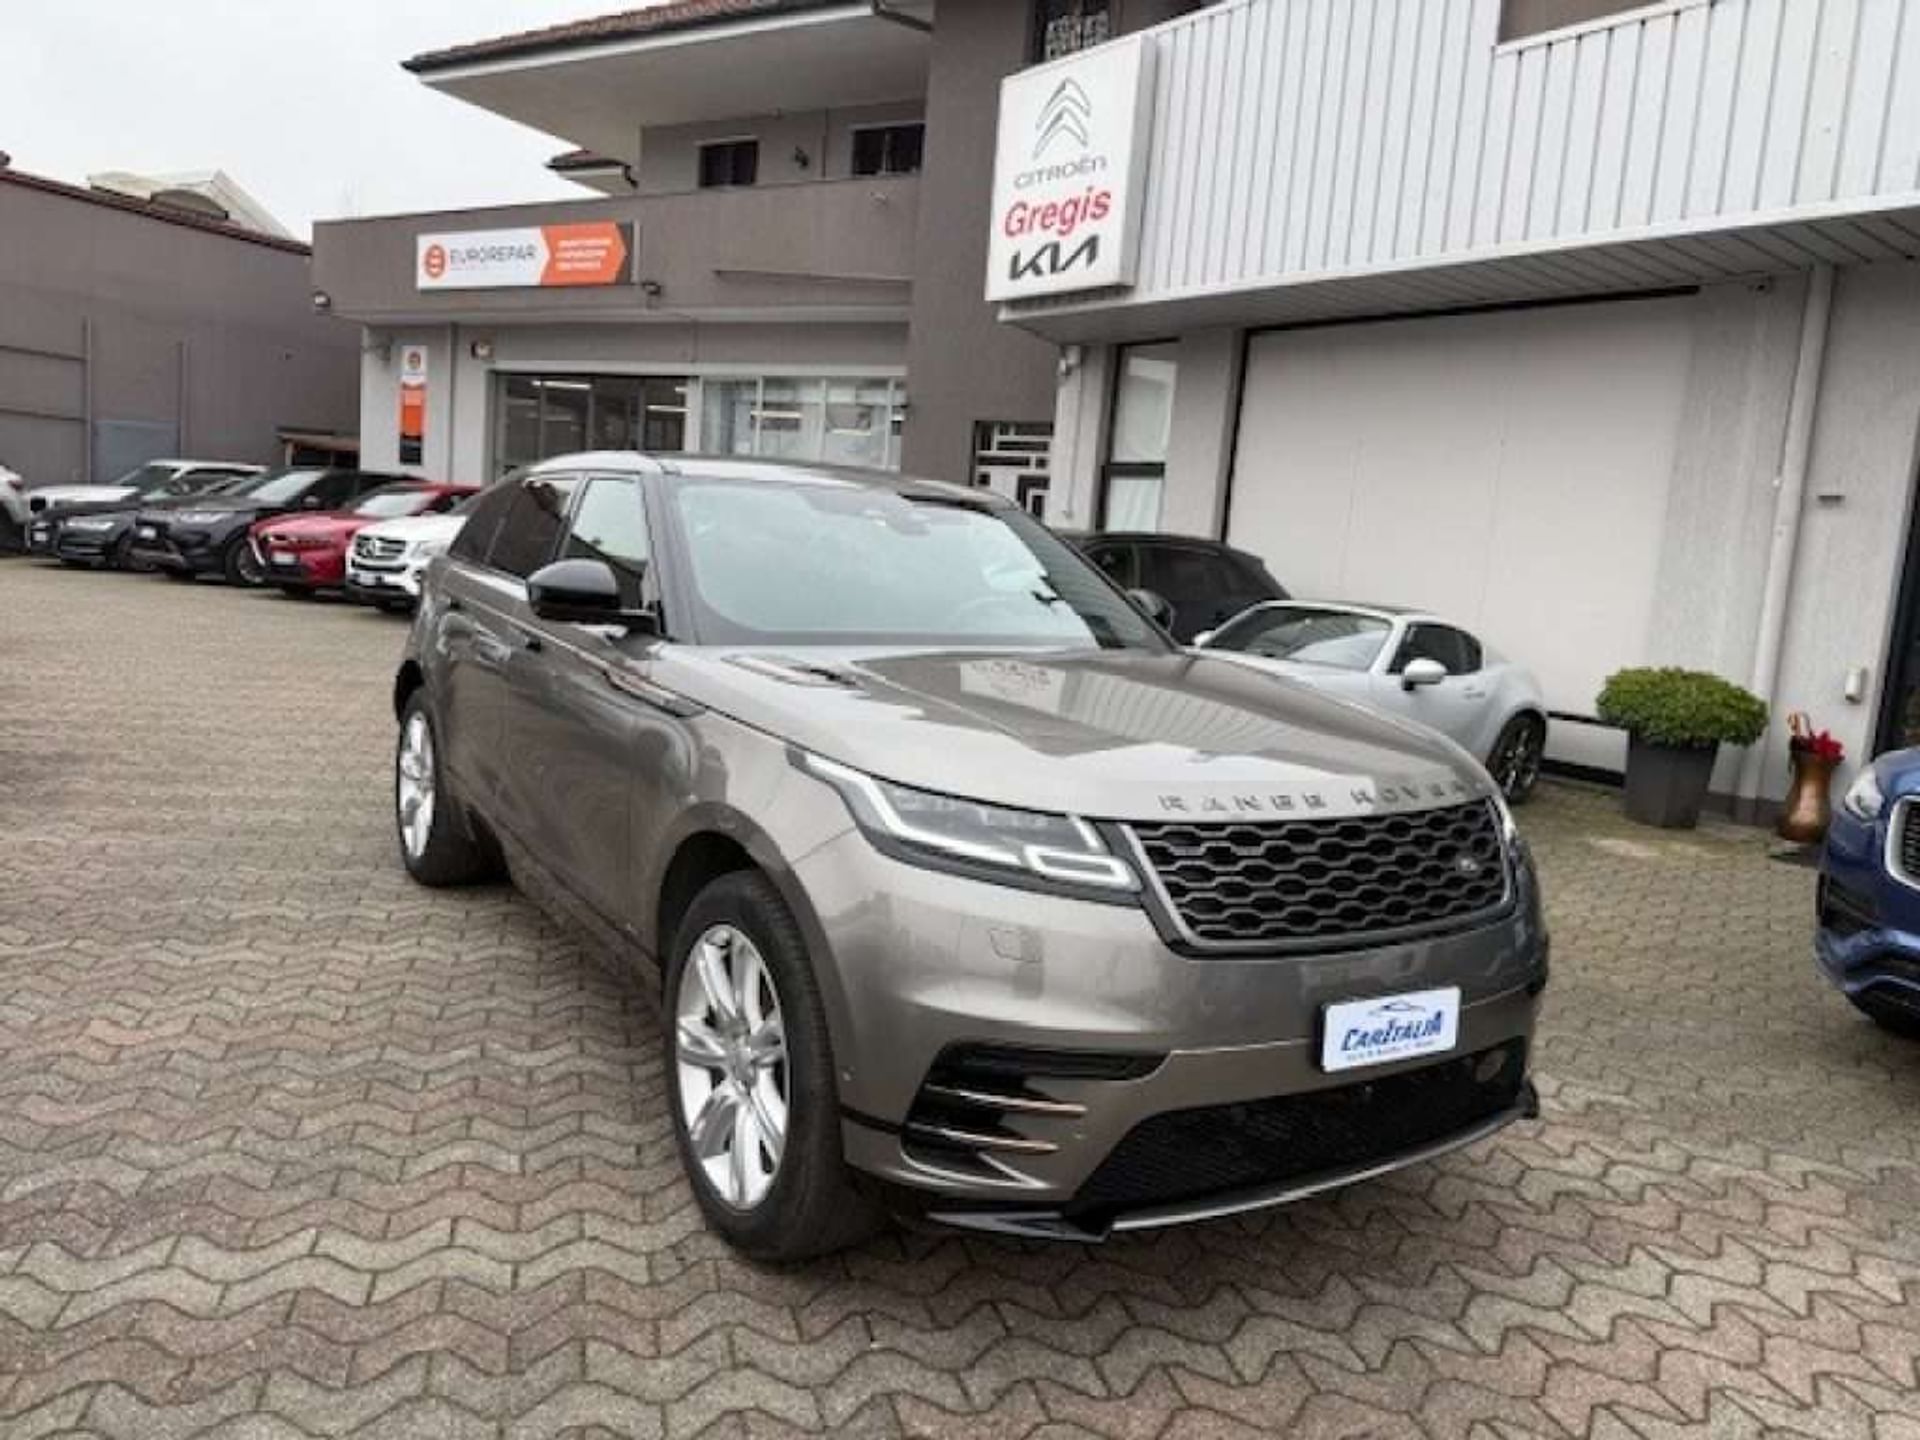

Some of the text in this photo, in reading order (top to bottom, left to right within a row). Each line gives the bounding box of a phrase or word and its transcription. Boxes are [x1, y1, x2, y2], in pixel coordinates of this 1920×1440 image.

[1004, 186, 1111, 237] Gregis
[1009, 234, 1099, 280] KIA
[1158, 794, 1327, 811] RANGE
